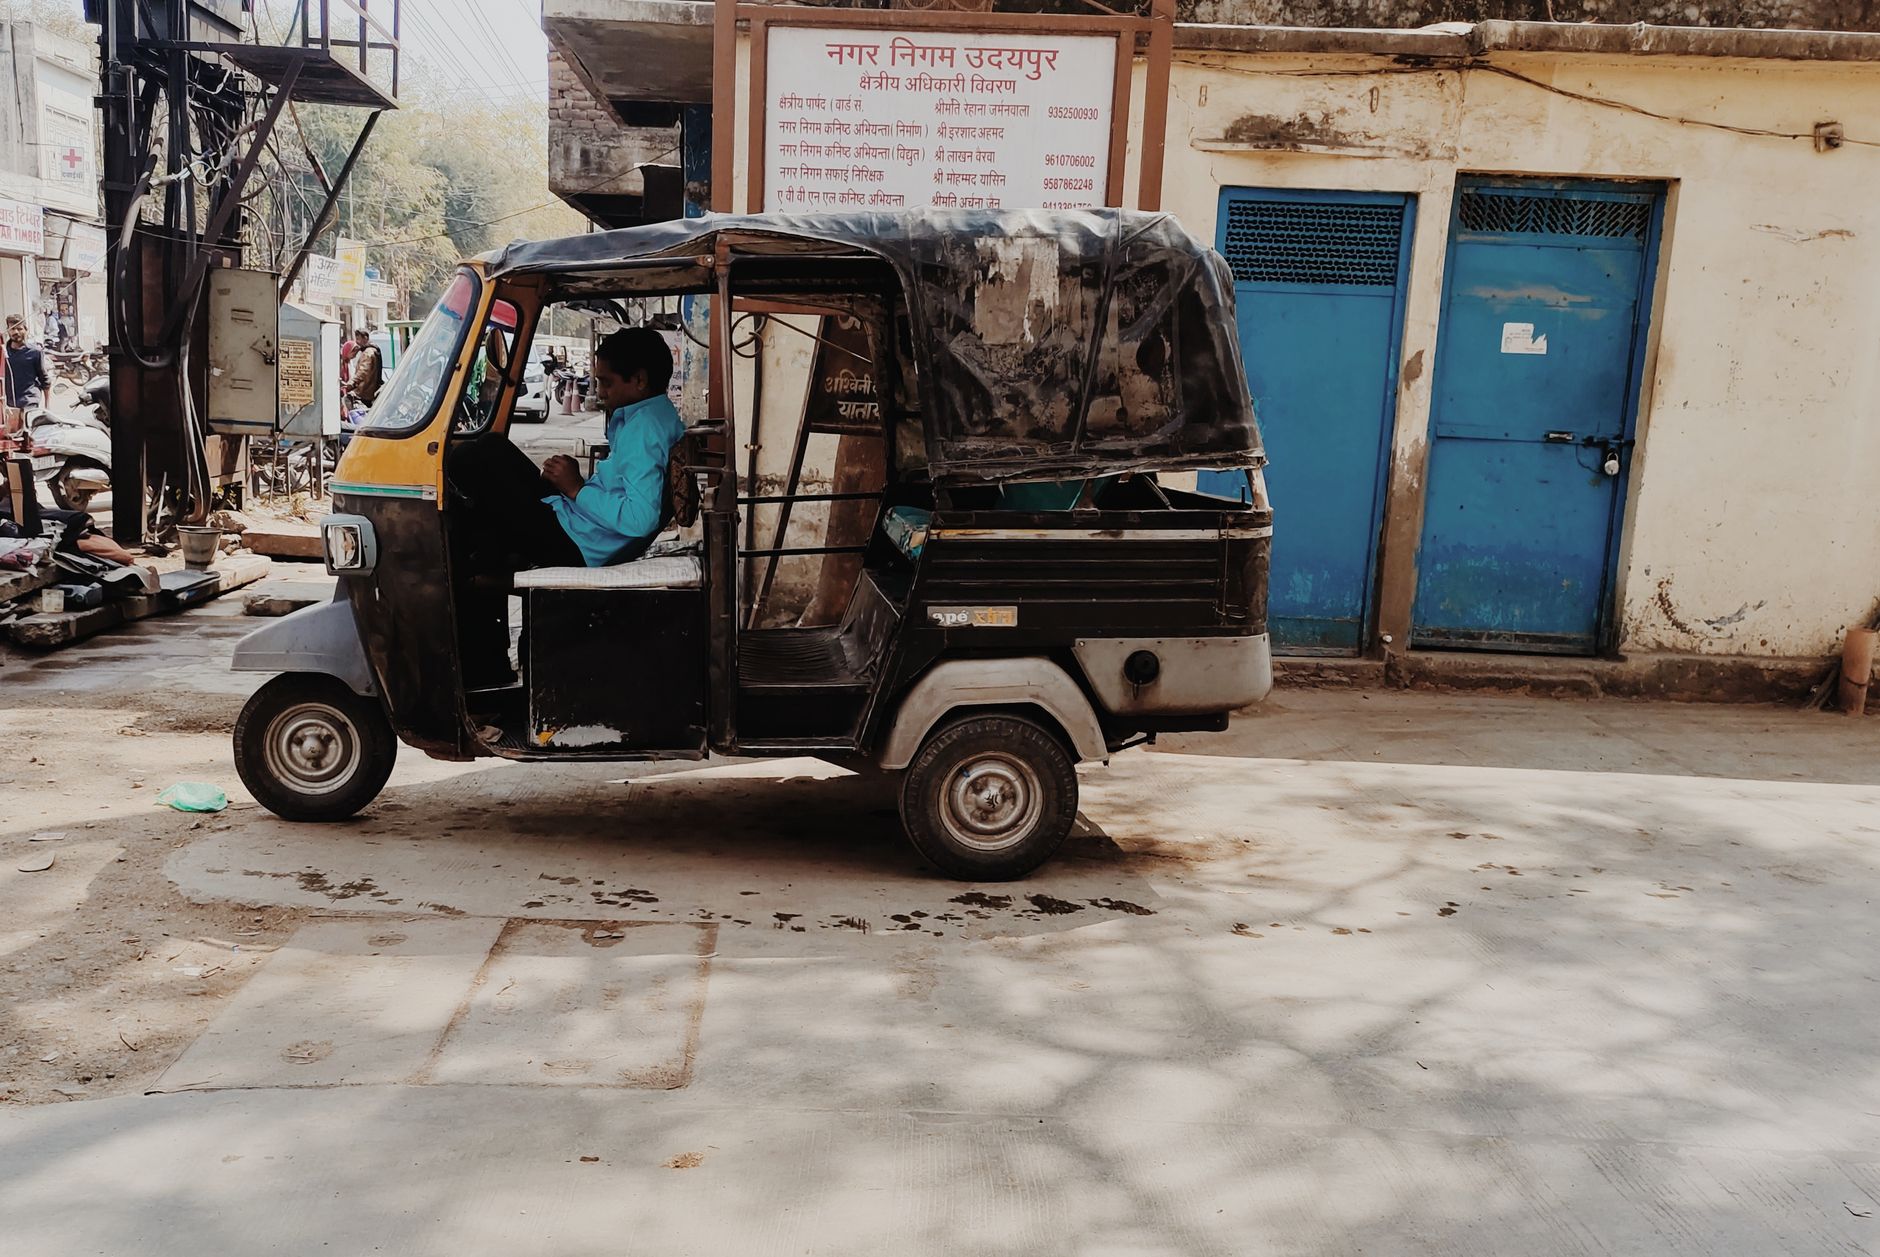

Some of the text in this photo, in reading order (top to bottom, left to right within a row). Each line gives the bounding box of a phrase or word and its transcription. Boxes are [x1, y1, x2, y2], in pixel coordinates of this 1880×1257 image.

[825, 36, 1059, 80] नगर निगम उदयपुर
[905, 71, 965, 93] अधिकारी
[970, 73, 1017, 94] विवरण
[1047, 105, 1099, 121] 9352500930
[778, 120, 797, 134] नगर
[799, 116, 822, 135] निगम
[936, 121, 1005, 142] श्री इरशाद अहमद
[779, 143, 797, 158] नगर
[799, 139, 822, 158] निगम
[934, 145, 945, 163] श्री
[947, 149, 973, 164] लाखन
[1044, 153, 1095, 168] 9610706002
[779, 166, 798, 180] नगर
[799, 162, 822, 181] निगम
[824, 164, 850, 184] सफाई
[932, 167, 944, 186] श्री
[979, 169, 1006, 187] यासिन
[1043, 177, 1094, 191] 9587862248
[14, 228, 41, 244] TIMBER
